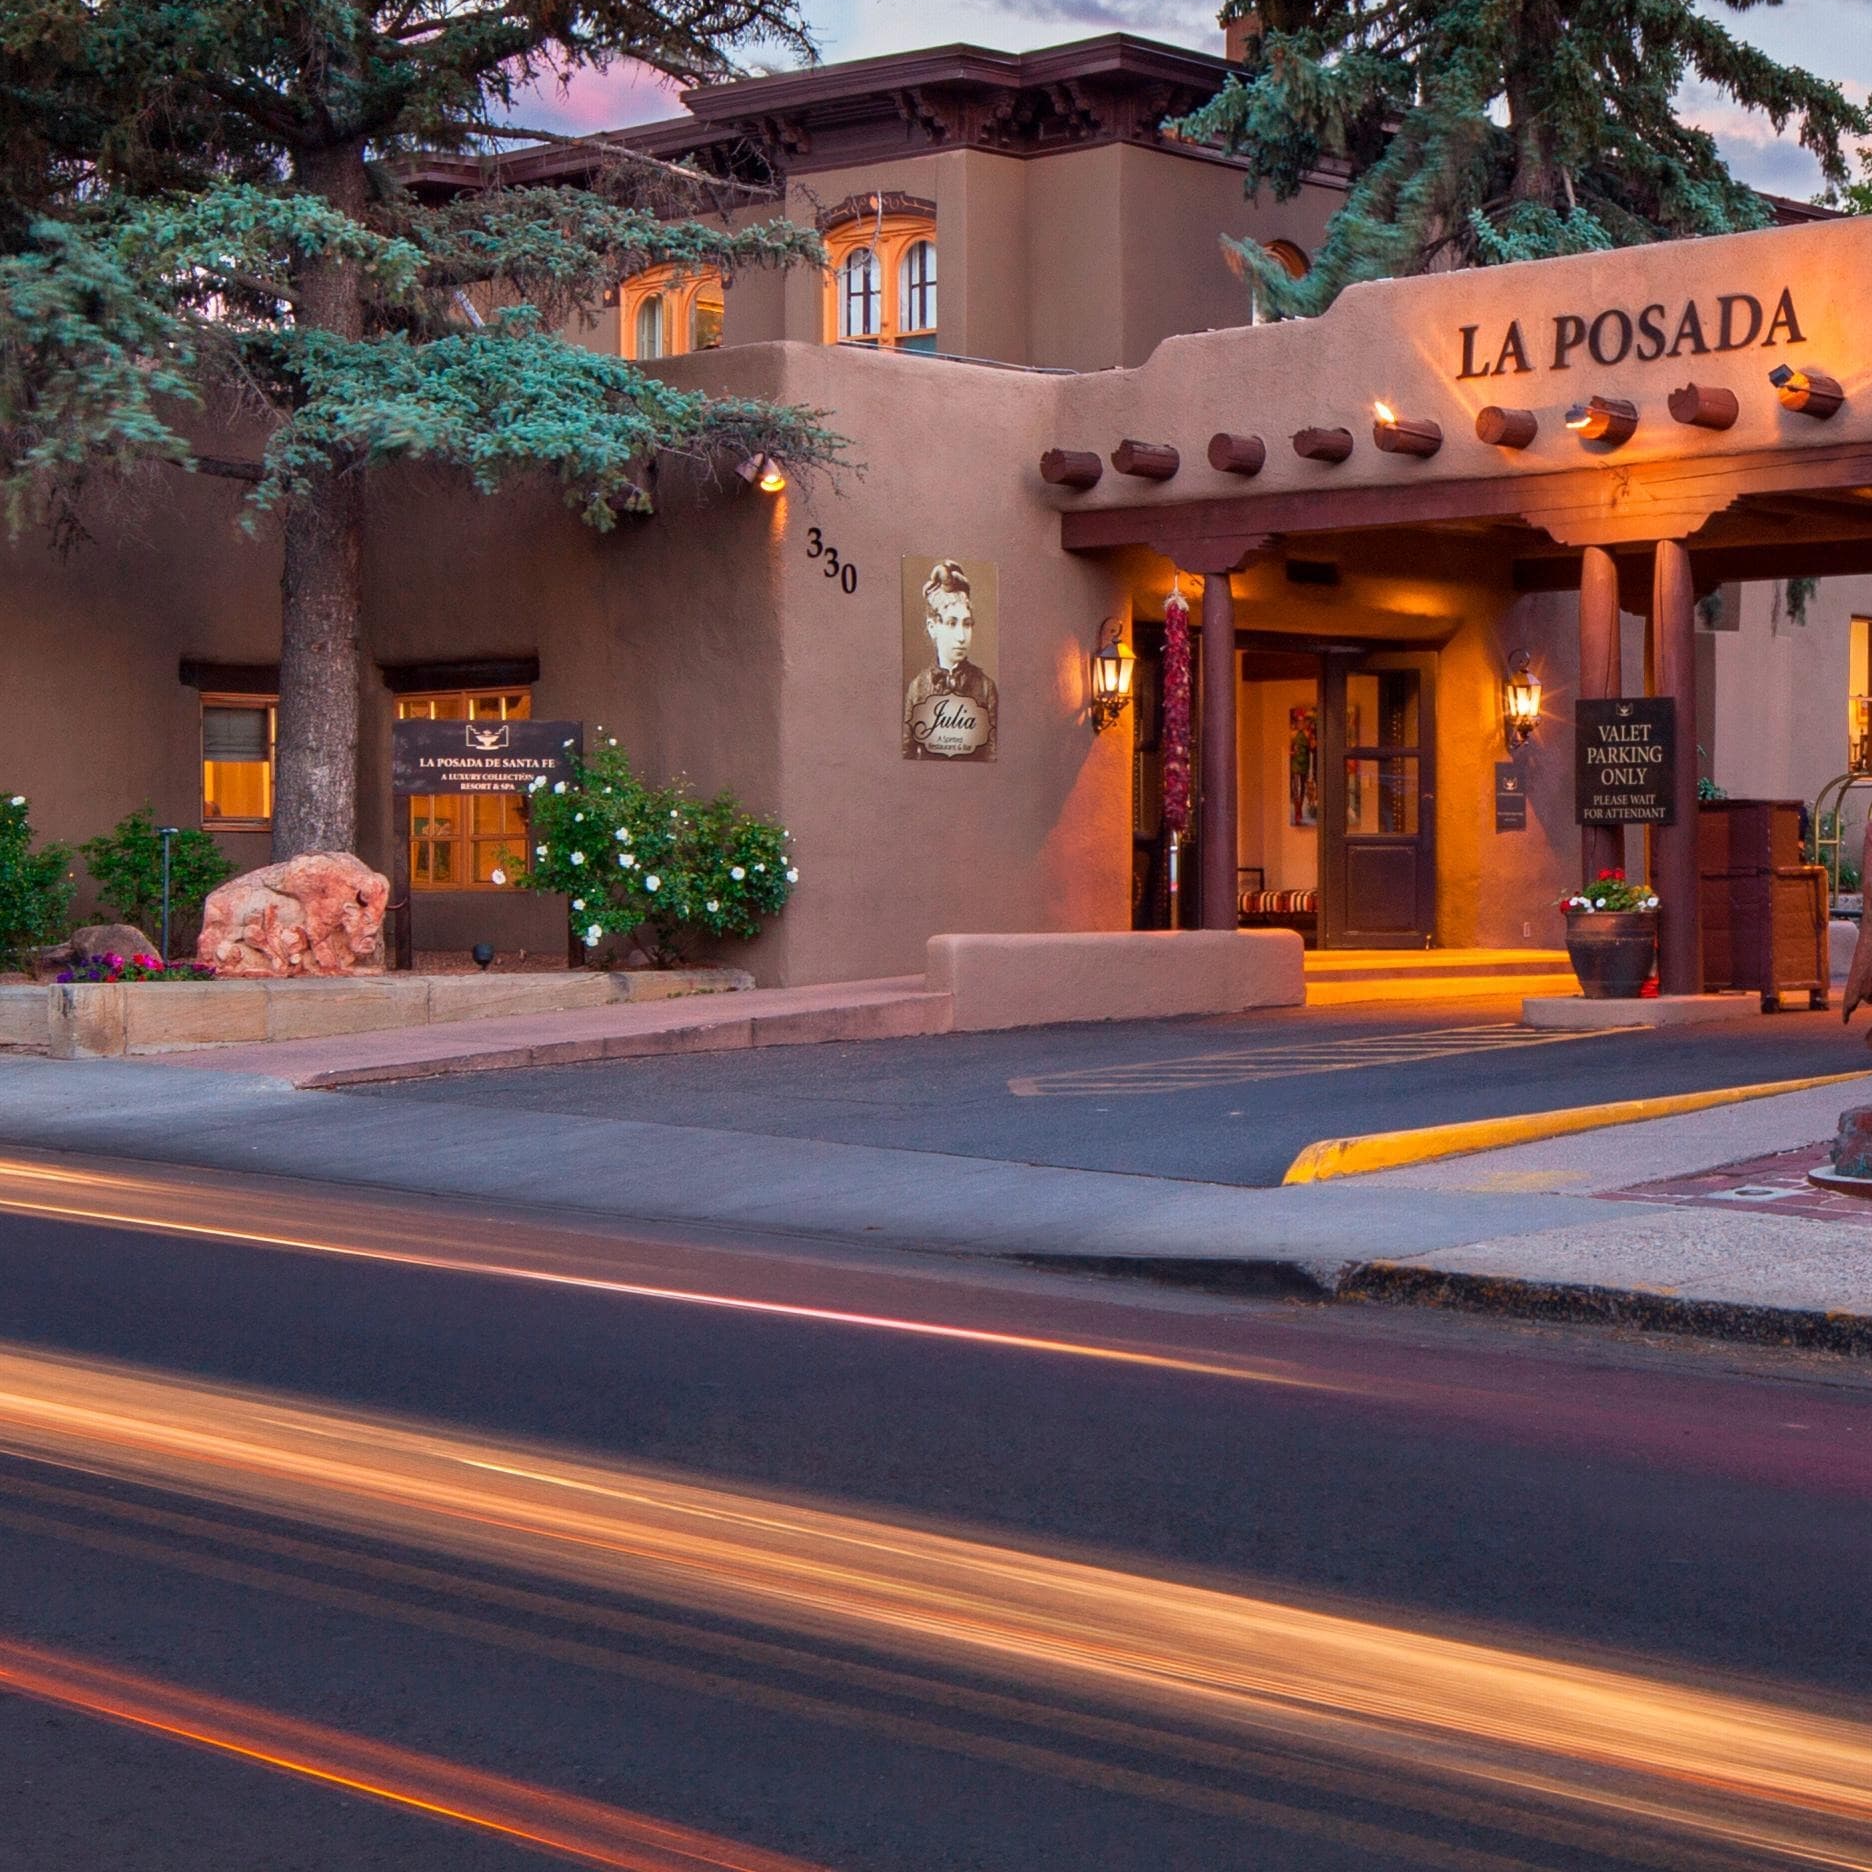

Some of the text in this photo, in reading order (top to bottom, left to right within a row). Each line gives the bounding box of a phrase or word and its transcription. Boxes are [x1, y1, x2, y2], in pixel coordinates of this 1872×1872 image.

[1455, 286, 1807, 380] LA POSADA
[806, 527, 858, 595] 330
[914, 699, 976, 741] Julia
[1598, 724, 1652, 742] VALET
[419, 758, 556, 768] LA POSADA DE SANTA FE
[1586, 745, 1663, 764] PARKING
[441, 773, 534, 781] A LUXURY COLLECTION
[460, 782, 515, 790] RESORT & SPA
[1601, 768, 1648, 786] ONLY
[1593, 794, 1656, 806] PLEASE WAIT
[1584, 807, 1666, 819] FOR ATTENDANT
